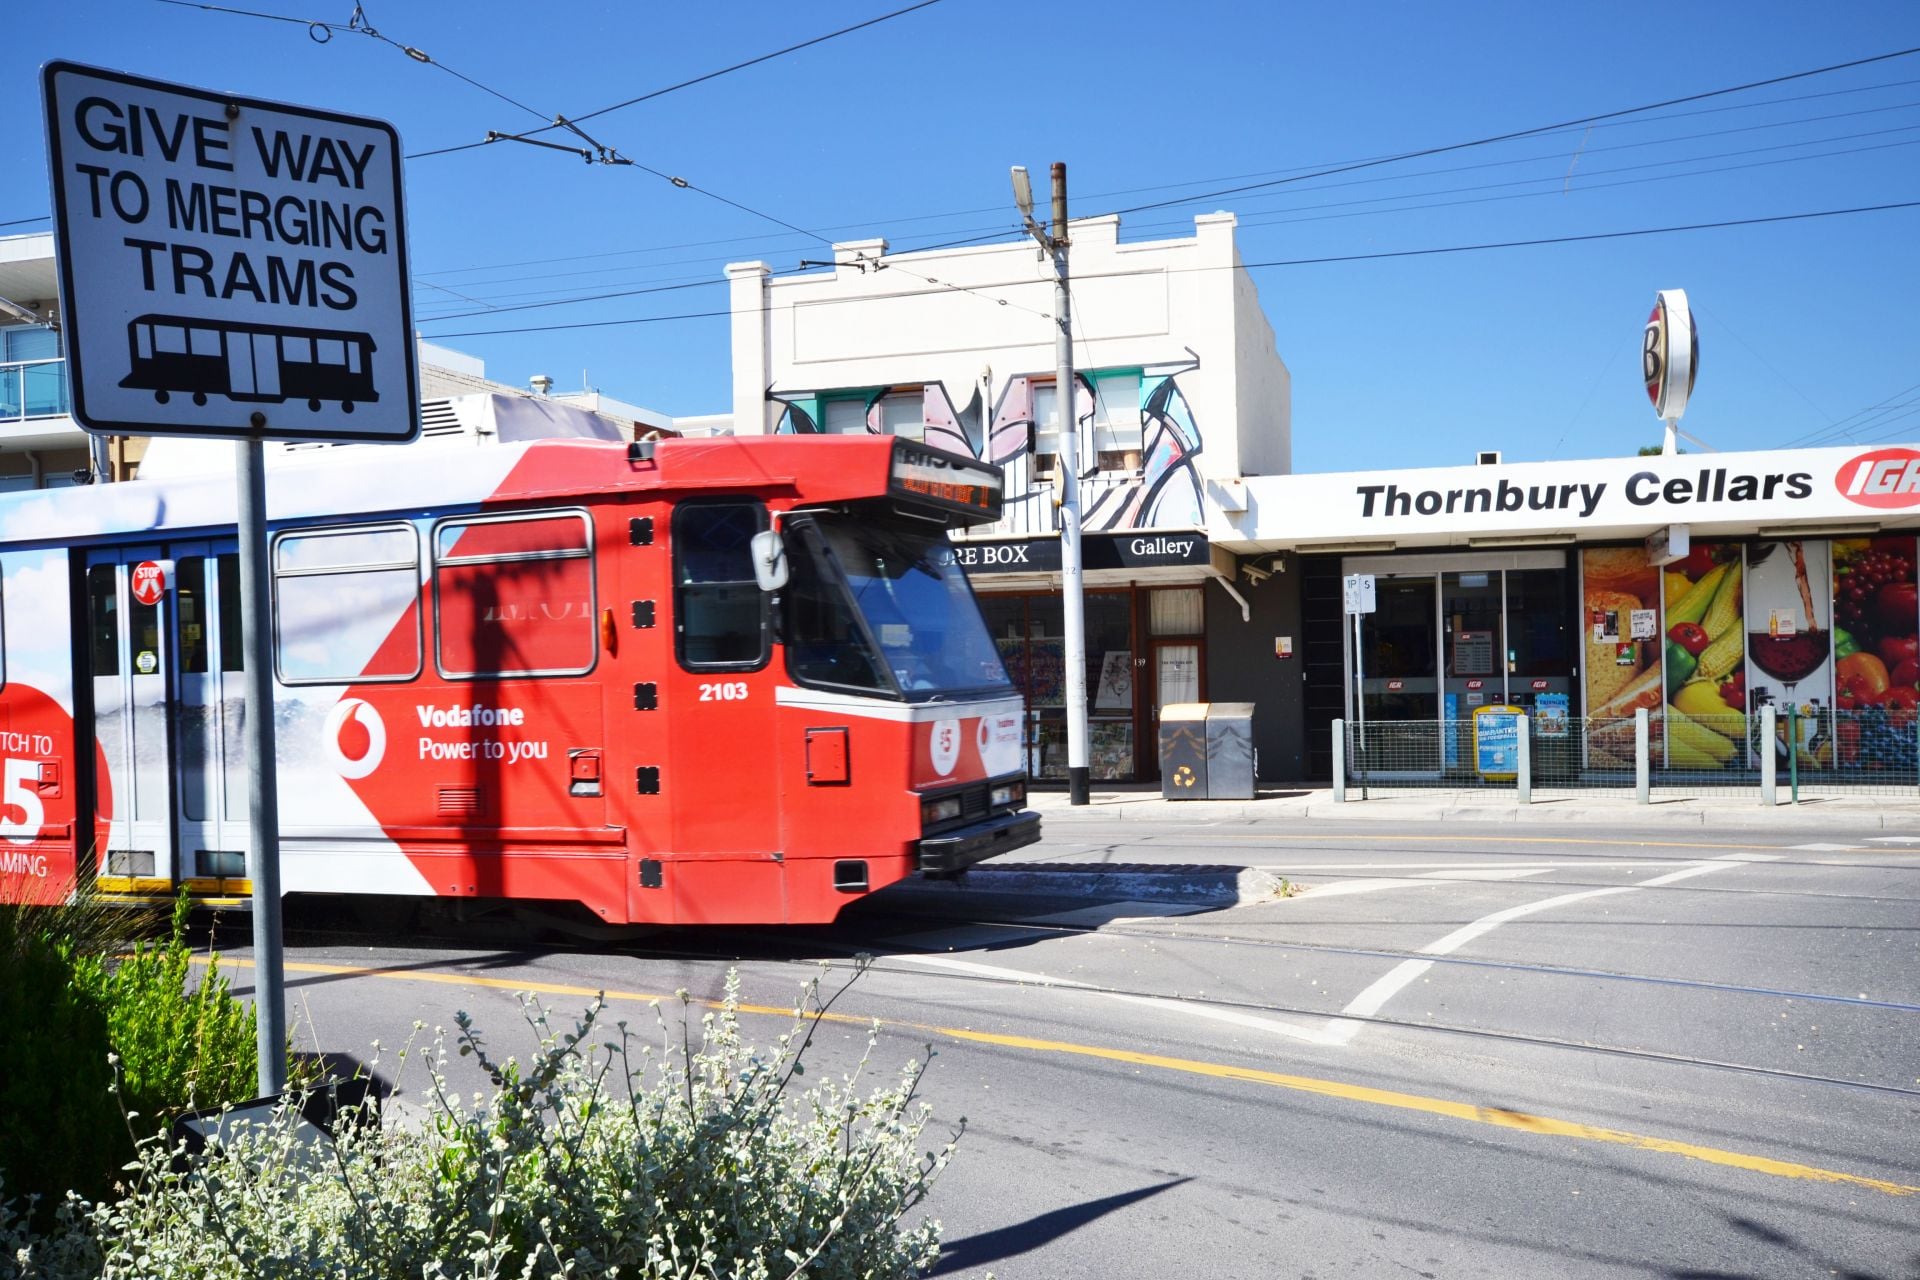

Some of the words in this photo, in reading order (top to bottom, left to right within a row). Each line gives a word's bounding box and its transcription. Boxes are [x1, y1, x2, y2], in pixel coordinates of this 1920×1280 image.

[74, 97, 234, 172] GIVE
[251, 126, 375, 189] WAY
[76, 163, 149, 224] TO
[165, 178, 388, 254] MERGING
[124, 238, 357, 310] TRAMS
[1846, 459, 1920, 495] IGA
[1357, 479, 1607, 517] Thornbury
[1625, 468, 1813, 506] Cellars
[982, 545, 1029, 564] BOX
[1130, 537, 1194, 557] Gallery
[137, 567, 161, 579] STOP
[699, 682, 749, 701] 2103
[416, 704, 525, 727] Vodafone
[32, 735, 53, 756] TO
[419, 737, 479, 760] Power
[483, 739, 505, 759] to
[508, 741, 548, 764] you
